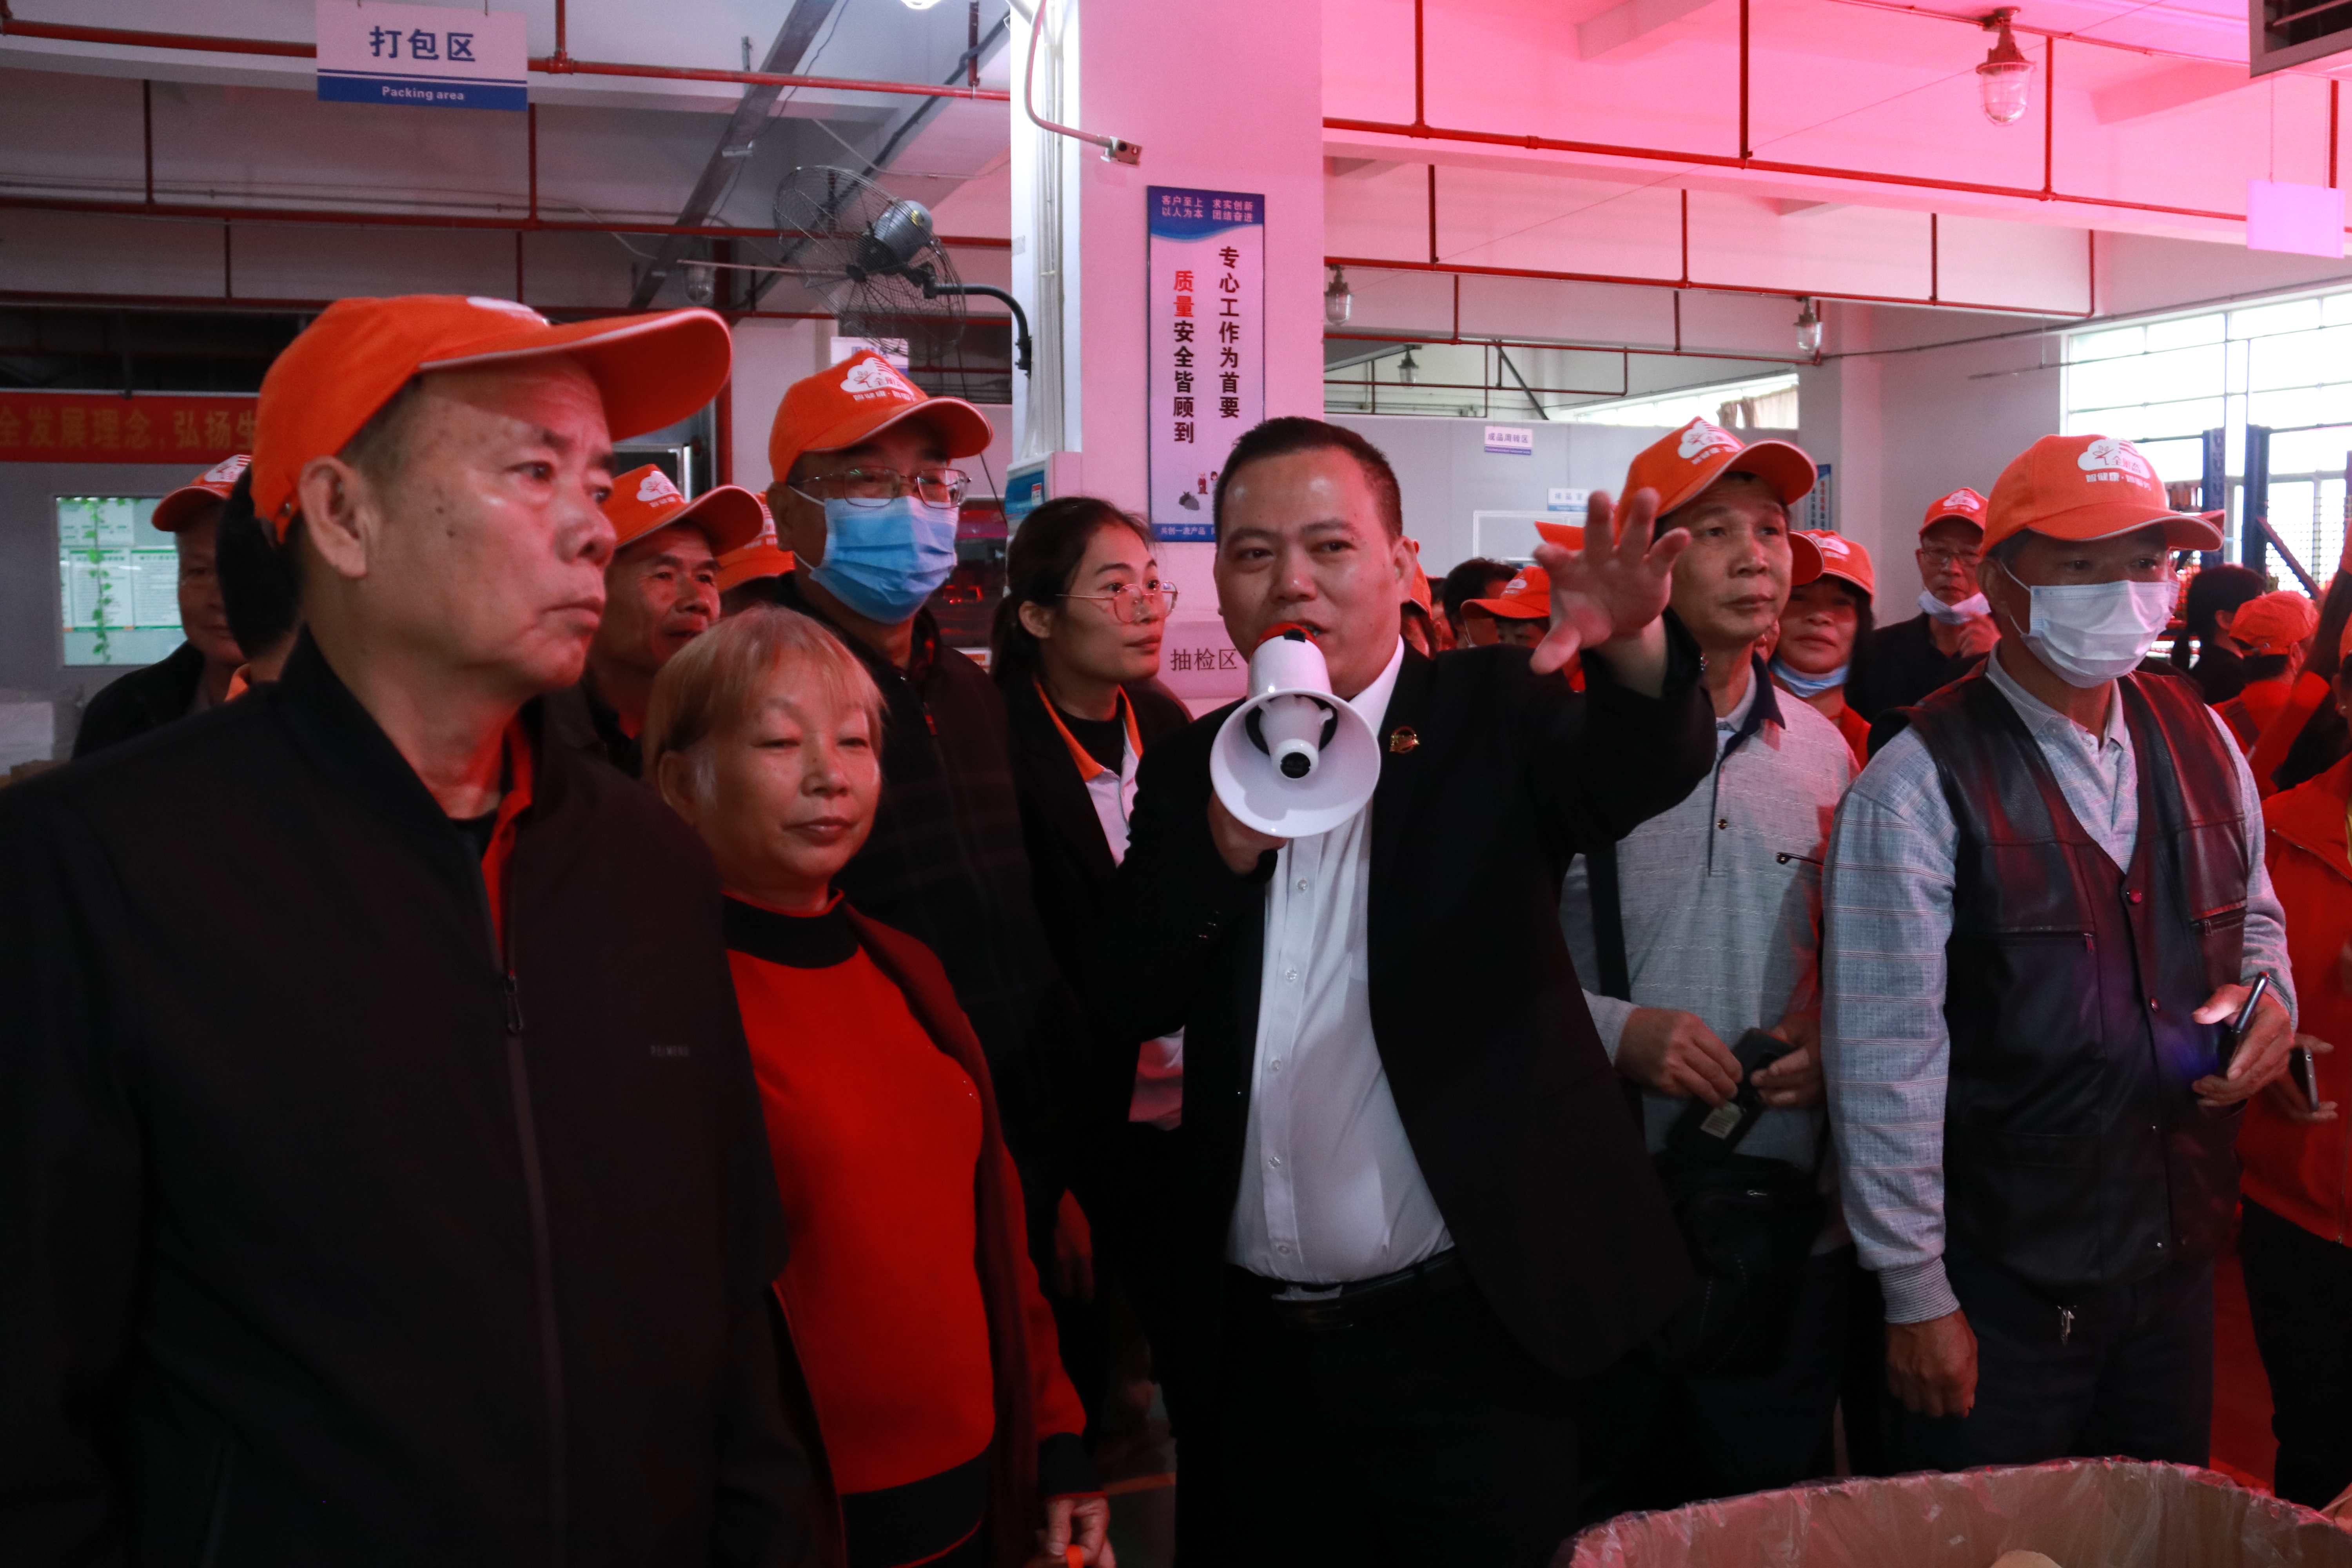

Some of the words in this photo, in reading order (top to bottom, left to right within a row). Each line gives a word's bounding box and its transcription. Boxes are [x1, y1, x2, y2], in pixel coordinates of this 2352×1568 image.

[369, 25, 475, 62] 打包区
[382, 86, 433, 100] Packing
[436, 92, 464, 101] area
[1162, 195, 1203, 207] 客户至上
[1212, 199, 1254, 212] 求实创新
[1162, 207, 1203, 219] 以人为本
[1212, 209, 1253, 223] 团结奋进
[1219, 246, 1240, 419] 专心工作为首要
[1173, 270, 1194, 443] 质量安全皆顾到
[1488, 432, 1528, 443] 成品周转区
[1170, 648, 1237, 671] 抽检区
